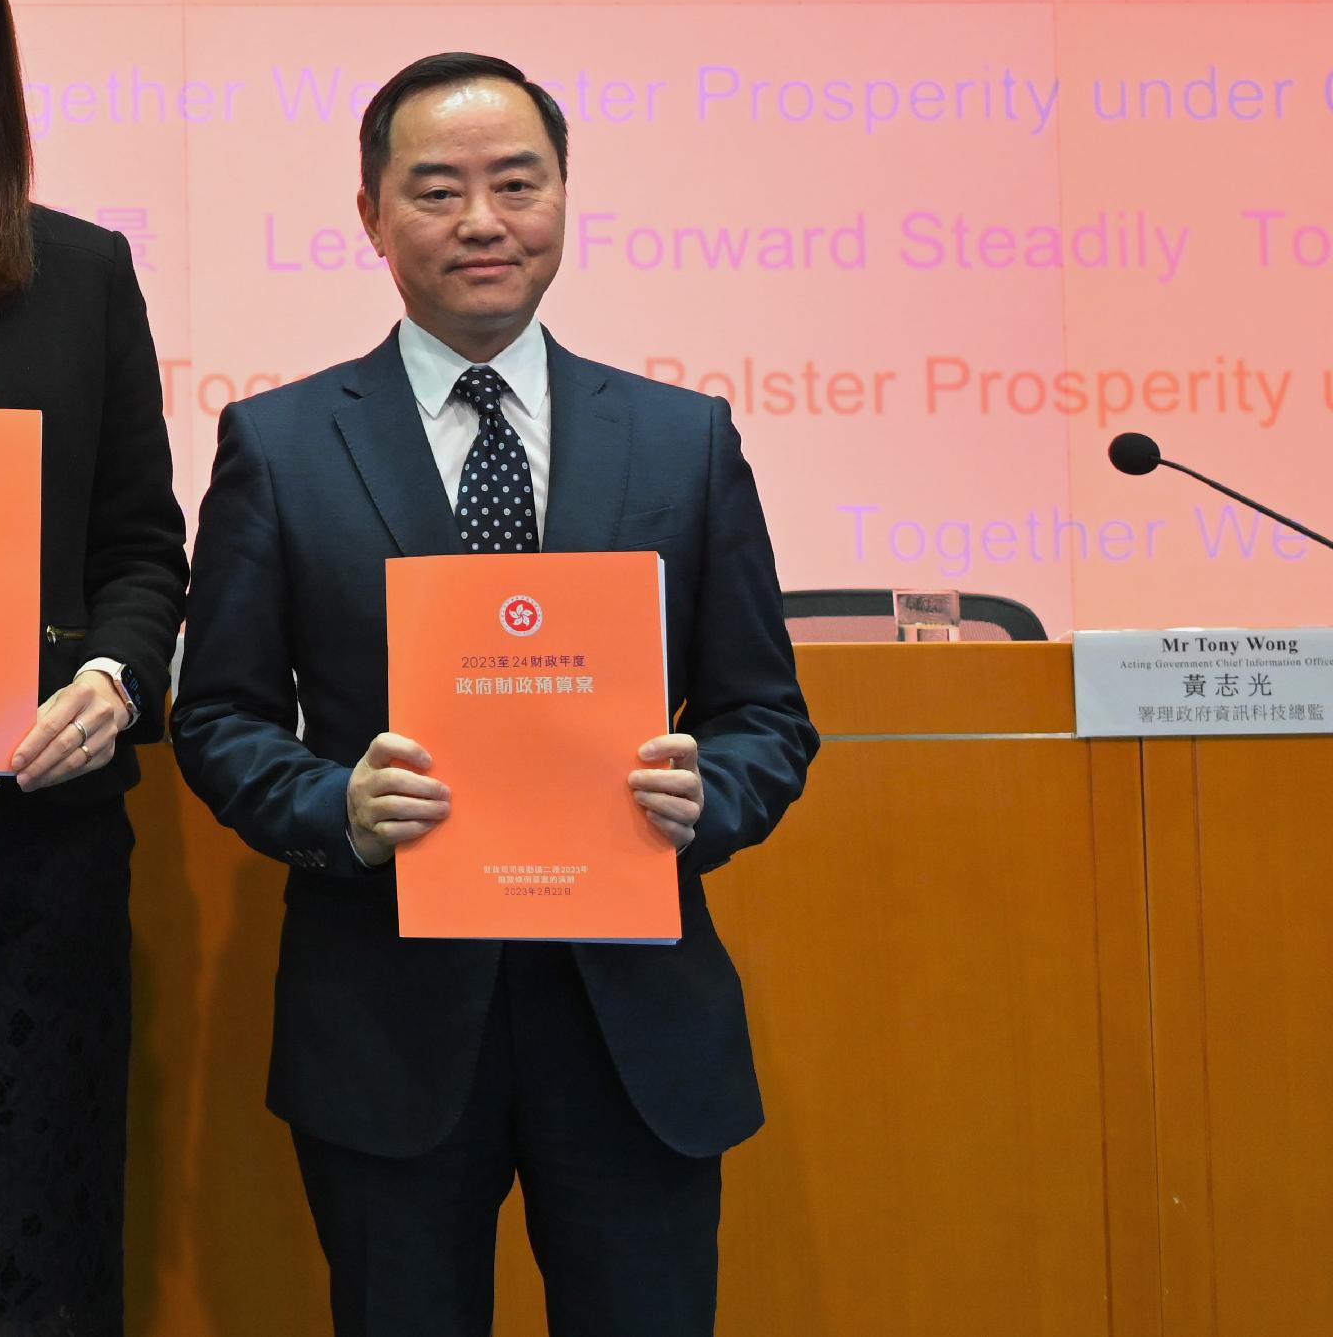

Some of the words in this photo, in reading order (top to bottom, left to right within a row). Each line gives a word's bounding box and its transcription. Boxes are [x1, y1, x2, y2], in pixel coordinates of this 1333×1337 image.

[696, 65, 1060, 135] Prosperity
[1093, 65, 1295, 121] under
[577, 211, 868, 271] Forward
[899, 210, 1190, 282] Steadily
[925, 356, 1292, 428] Prosperity
[837, 504, 1166, 577] Together
[1194, 504, 1310, 560] We
[1161, 637, 1189, 653] Mr
[1195, 637, 1240, 656] Tony
[1247, 636, 1299, 654] Wong
[461, 654, 586, 669] 2023至24財政年度
[1120, 660, 1152, 670] Acting
[1155, 660, 1213, 669] Government
[1216, 659, 1242, 668] Chief
[1245, 659, 1302, 668] Information
[455, 676, 596, 695] 政府財政預算案
[1183, 672, 1273, 697] 黃志光
[1138, 704, 1325, 723] 署理政府資訊科技總監
